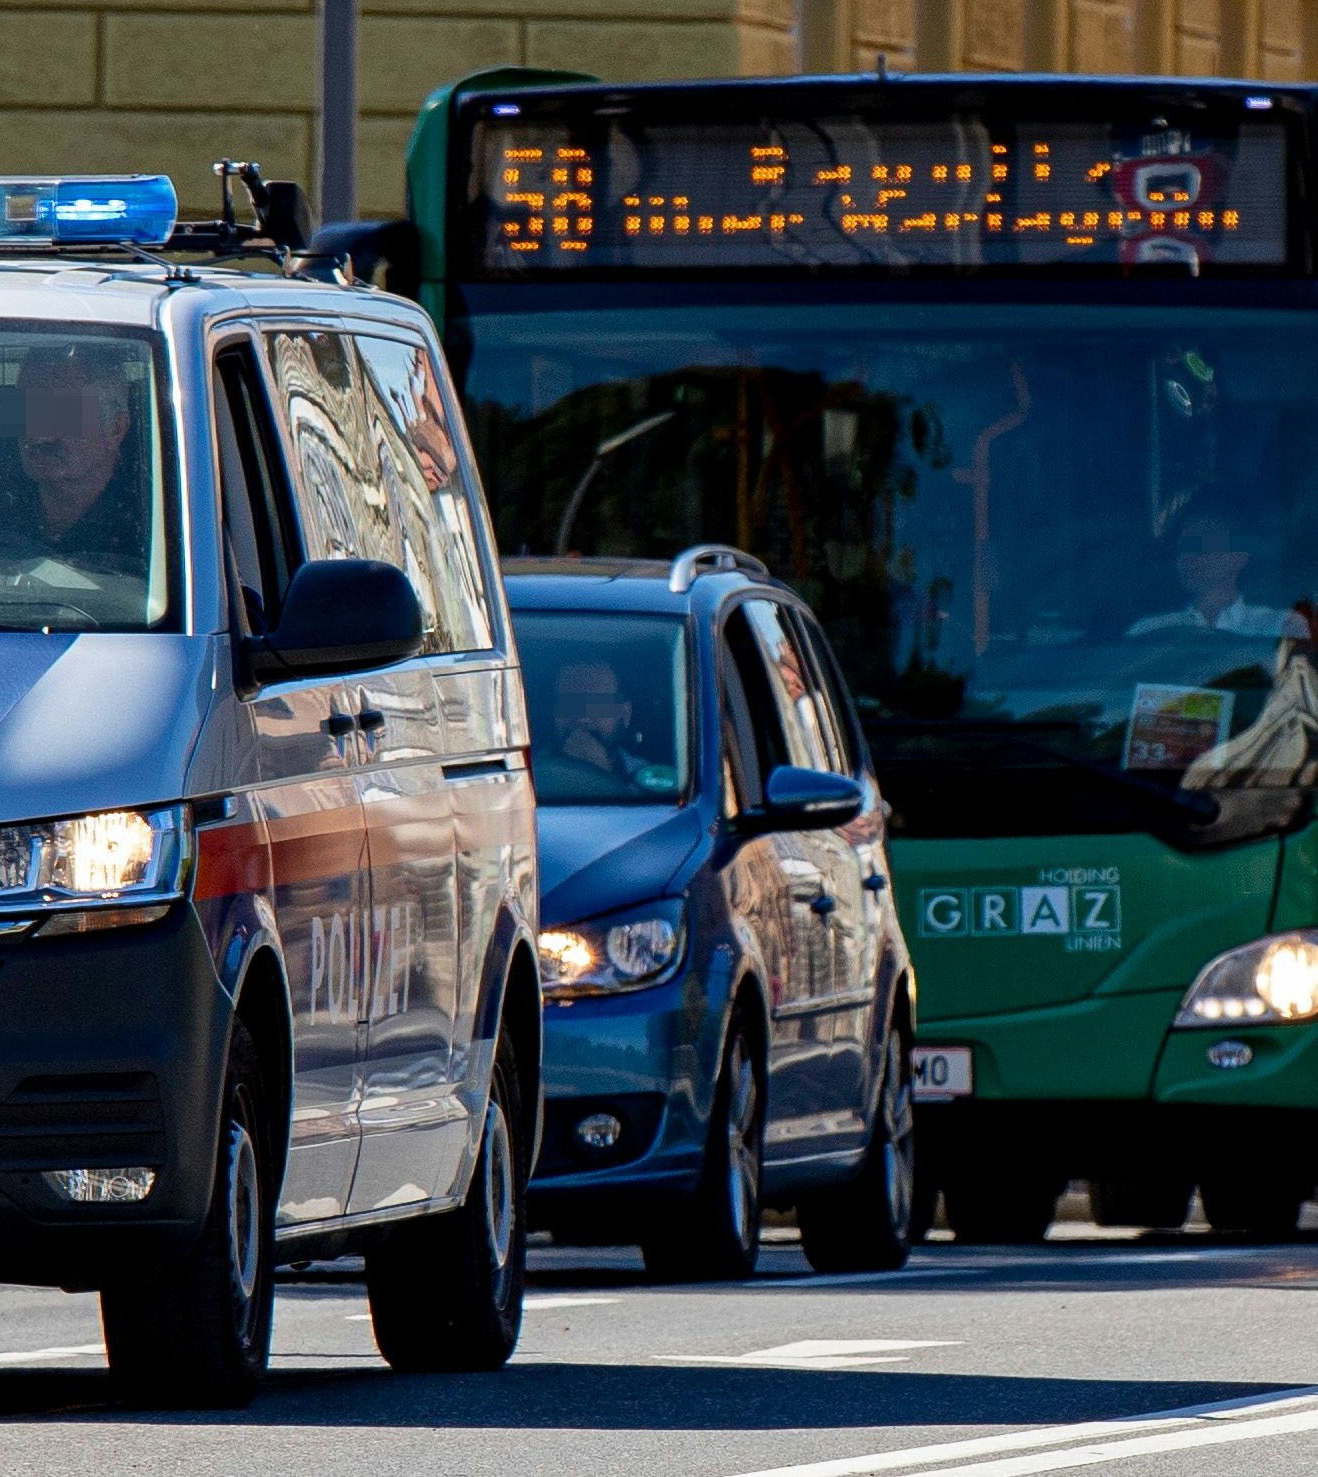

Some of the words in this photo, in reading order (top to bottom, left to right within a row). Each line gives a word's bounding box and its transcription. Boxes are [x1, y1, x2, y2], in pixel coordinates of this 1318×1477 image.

[1039, 867, 1119, 885] HOLDING
[925, 891, 1113, 931] GRAZ
[1065, 935, 1122, 952] LINIEN
[309, 903, 412, 1026] POLIZEI
